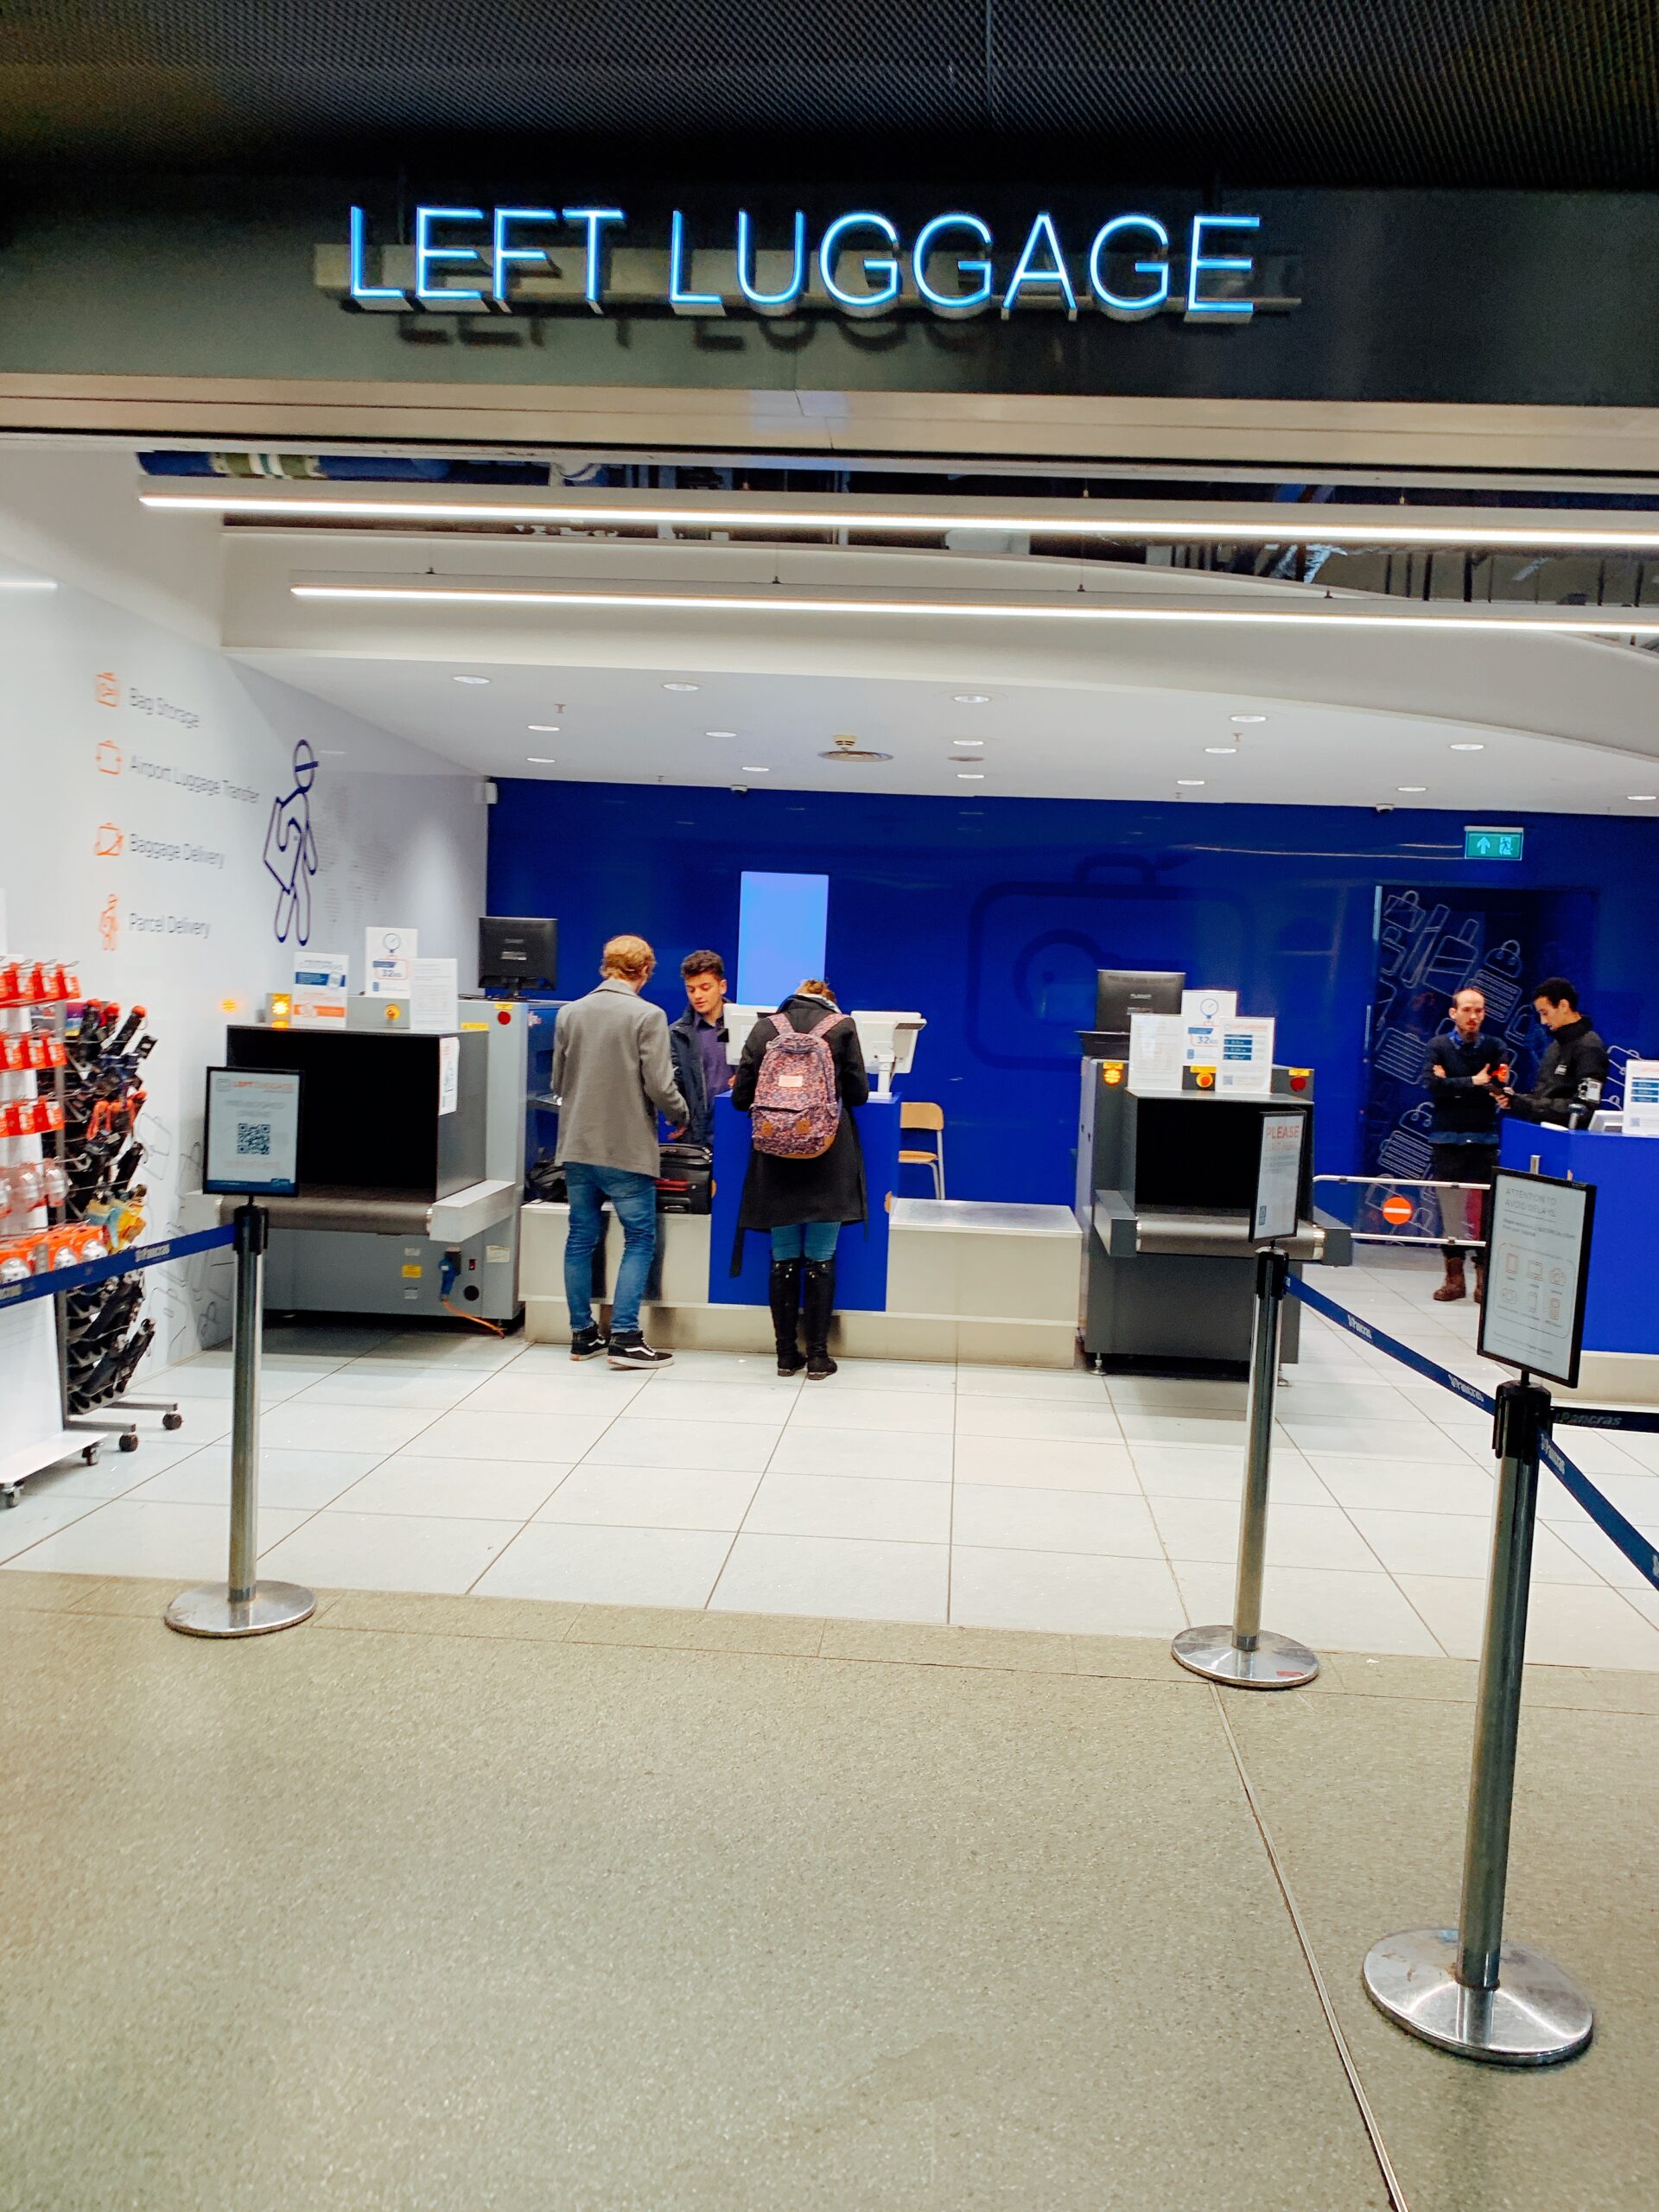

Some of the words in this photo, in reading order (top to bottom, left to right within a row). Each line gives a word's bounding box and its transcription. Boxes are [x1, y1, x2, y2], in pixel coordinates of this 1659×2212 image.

[348, 204, 626, 311] LEFT
[668, 207, 1263, 321] LUGGAGE
[129, 687, 153, 715] Bag
[156, 696, 200, 728] Storage
[130, 753, 171, 783] Airport
[173, 766, 220, 797] Luggage
[221, 779, 260, 804] Transfer
[130, 833, 181, 861] Baggage
[183, 842, 226, 870] Delivery
[130, 912, 164, 932] Parcel
[167, 916, 211, 939] Delivery
[1266, 1125, 1300, 1139] PLEASE
[1560, 1411, 1623, 1426] Pancras
